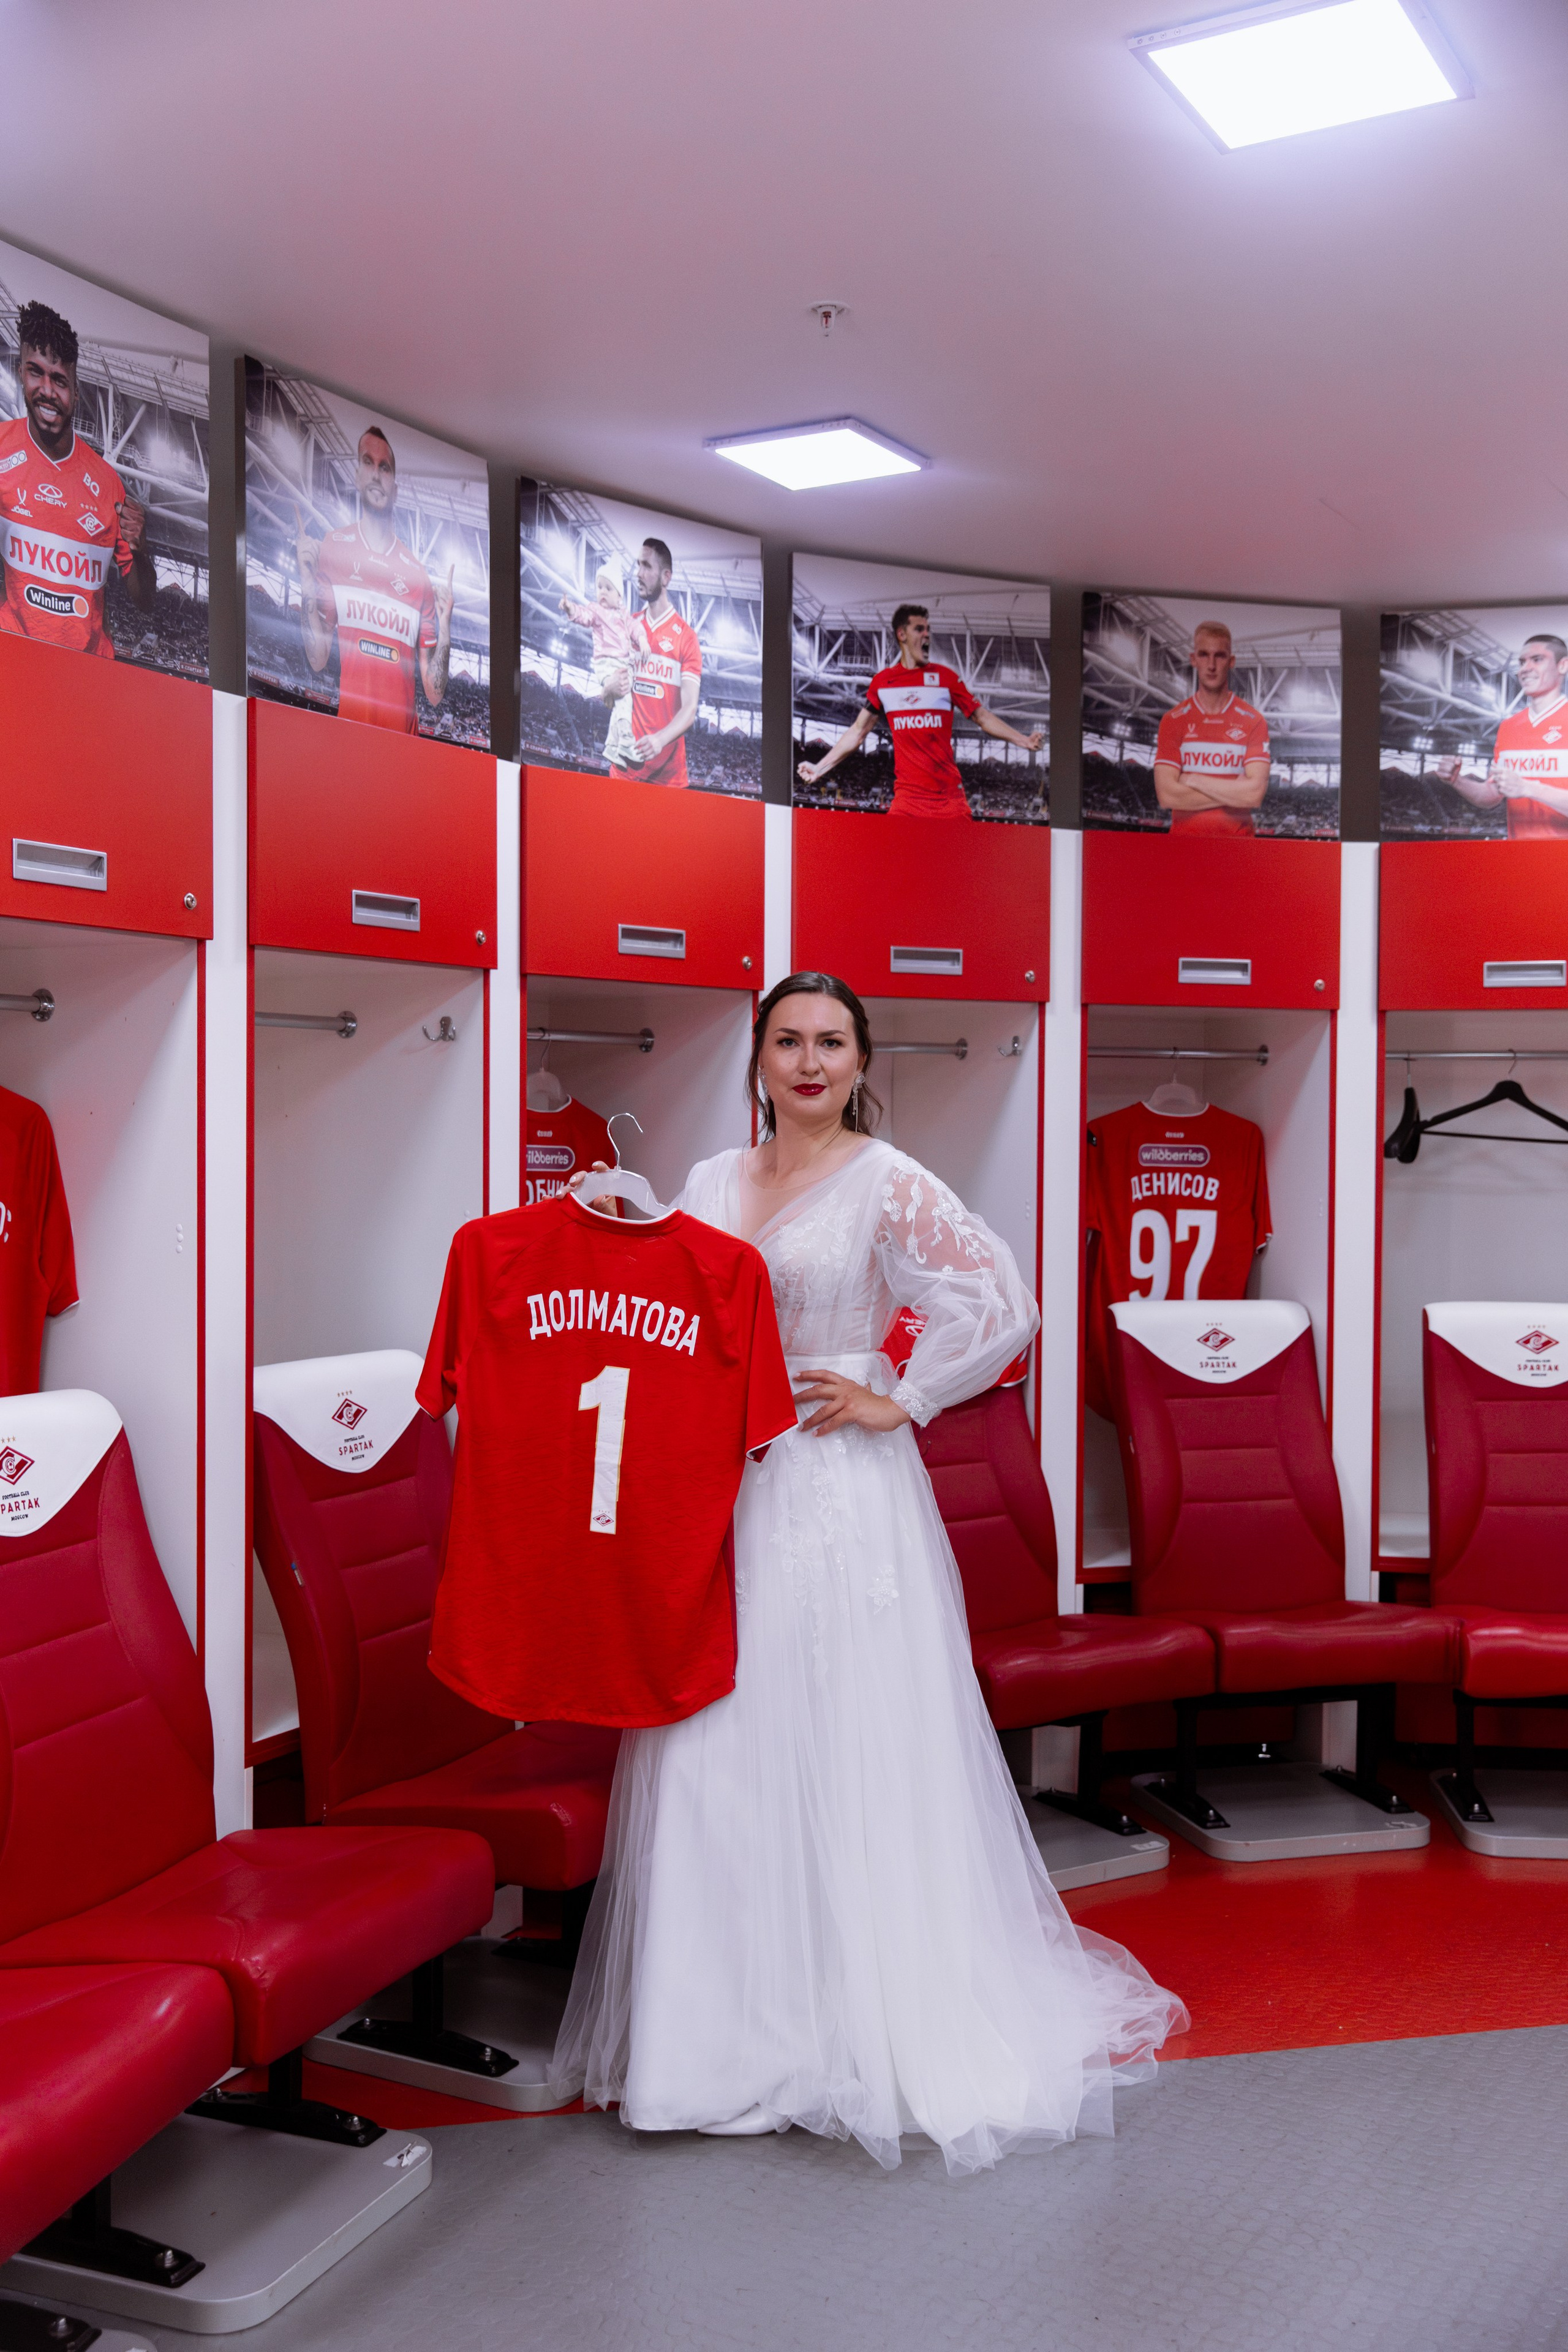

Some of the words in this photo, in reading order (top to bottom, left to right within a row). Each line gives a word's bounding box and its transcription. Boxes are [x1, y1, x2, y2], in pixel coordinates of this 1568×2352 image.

[34, 493, 67, 508] CHERY
[11, 505, 33, 518] JÖGEL
[9, 535, 102, 583] ЛУКОЙЛ
[30, 589, 70, 611] Winline
[346, 599, 410, 637] ЛУКОЙЛ
[361, 641, 391, 658] WINLINE
[634, 660, 673, 679] УКОЙЛ
[1183, 750, 1244, 767] ЛУКОЙЛ
[526, 1151, 569, 1164] ildberries
[1142, 1149, 1205, 1161] wildberries
[1131, 1172, 1219, 1202] ДЕНИСОВ
[1129, 1208, 1218, 1301] 97
[527, 1289, 700, 1356] ДОЛМАТОВА
[339, 1439, 374, 1455] SPARTAK
[578, 1365, 630, 1535] 1
[0, 1497, 40, 1514] PARTAK
